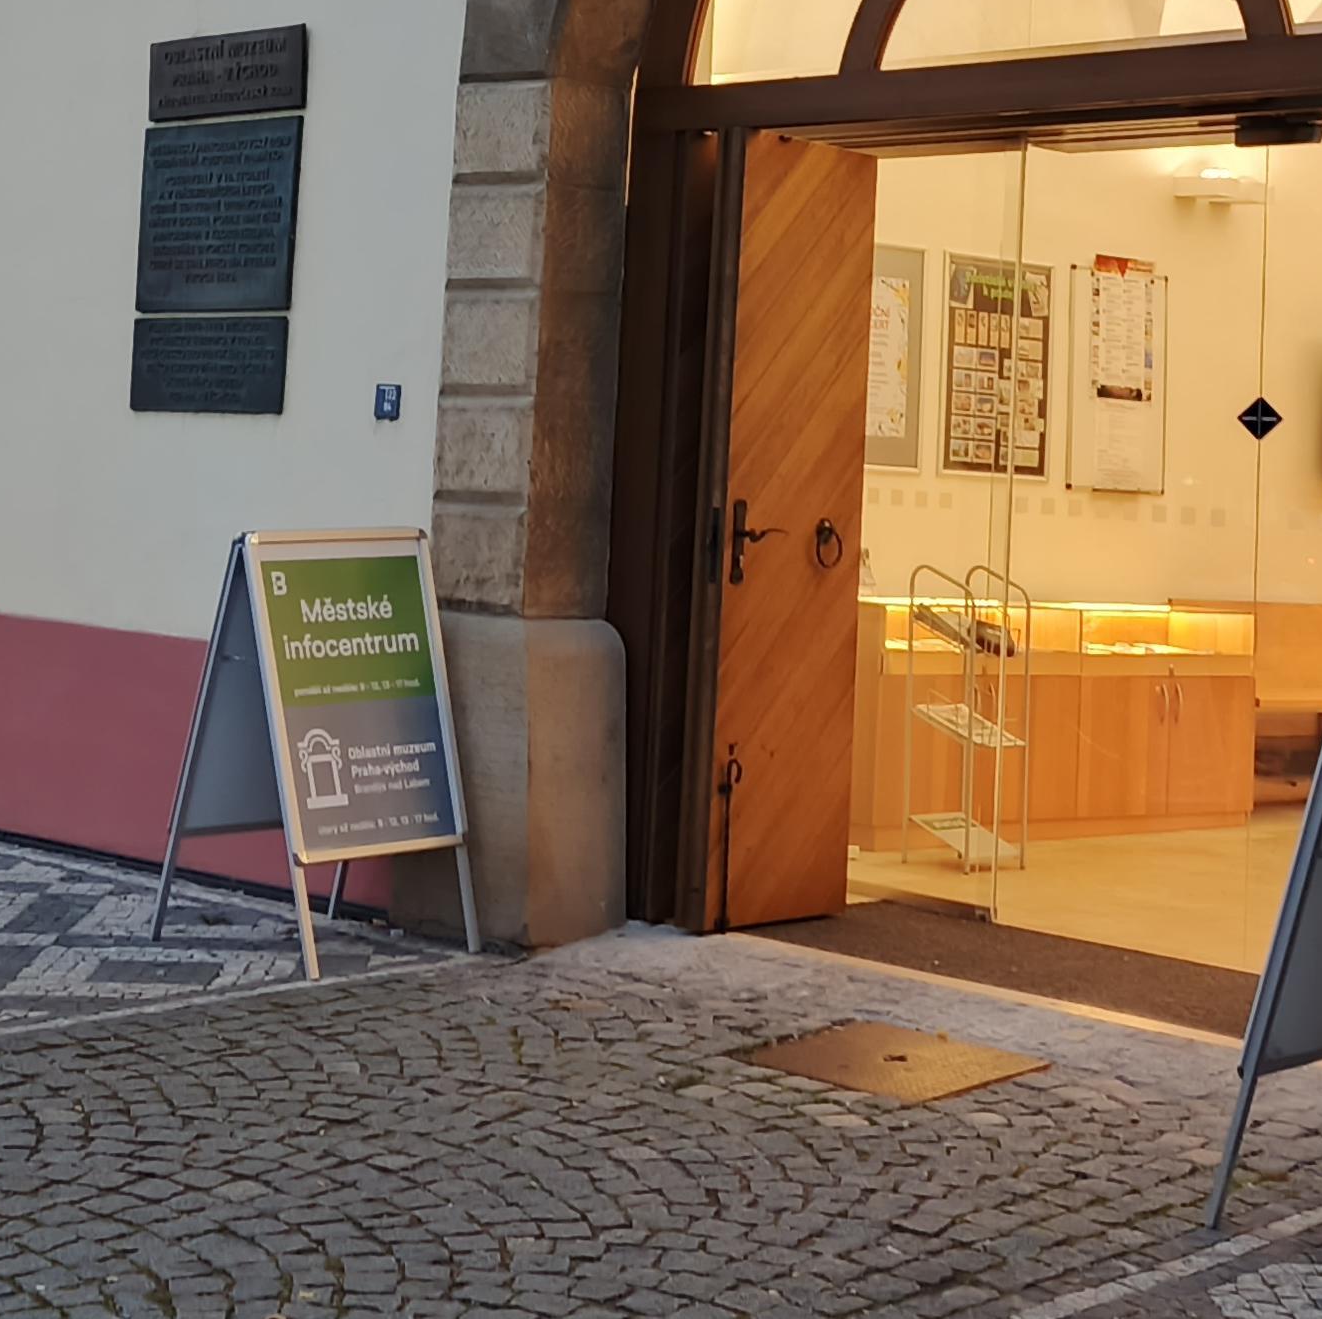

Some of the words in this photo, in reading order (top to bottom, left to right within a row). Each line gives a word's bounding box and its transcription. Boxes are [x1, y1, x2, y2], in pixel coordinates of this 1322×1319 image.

[271, 571, 287, 595] B
[300, 594, 393, 624] Městské
[283, 632, 419, 660] infocentrum
[348, 743, 391, 760] Oblastní
[393, 742, 436, 756] muzeum
[351, 759, 420, 778] Praha-východ
